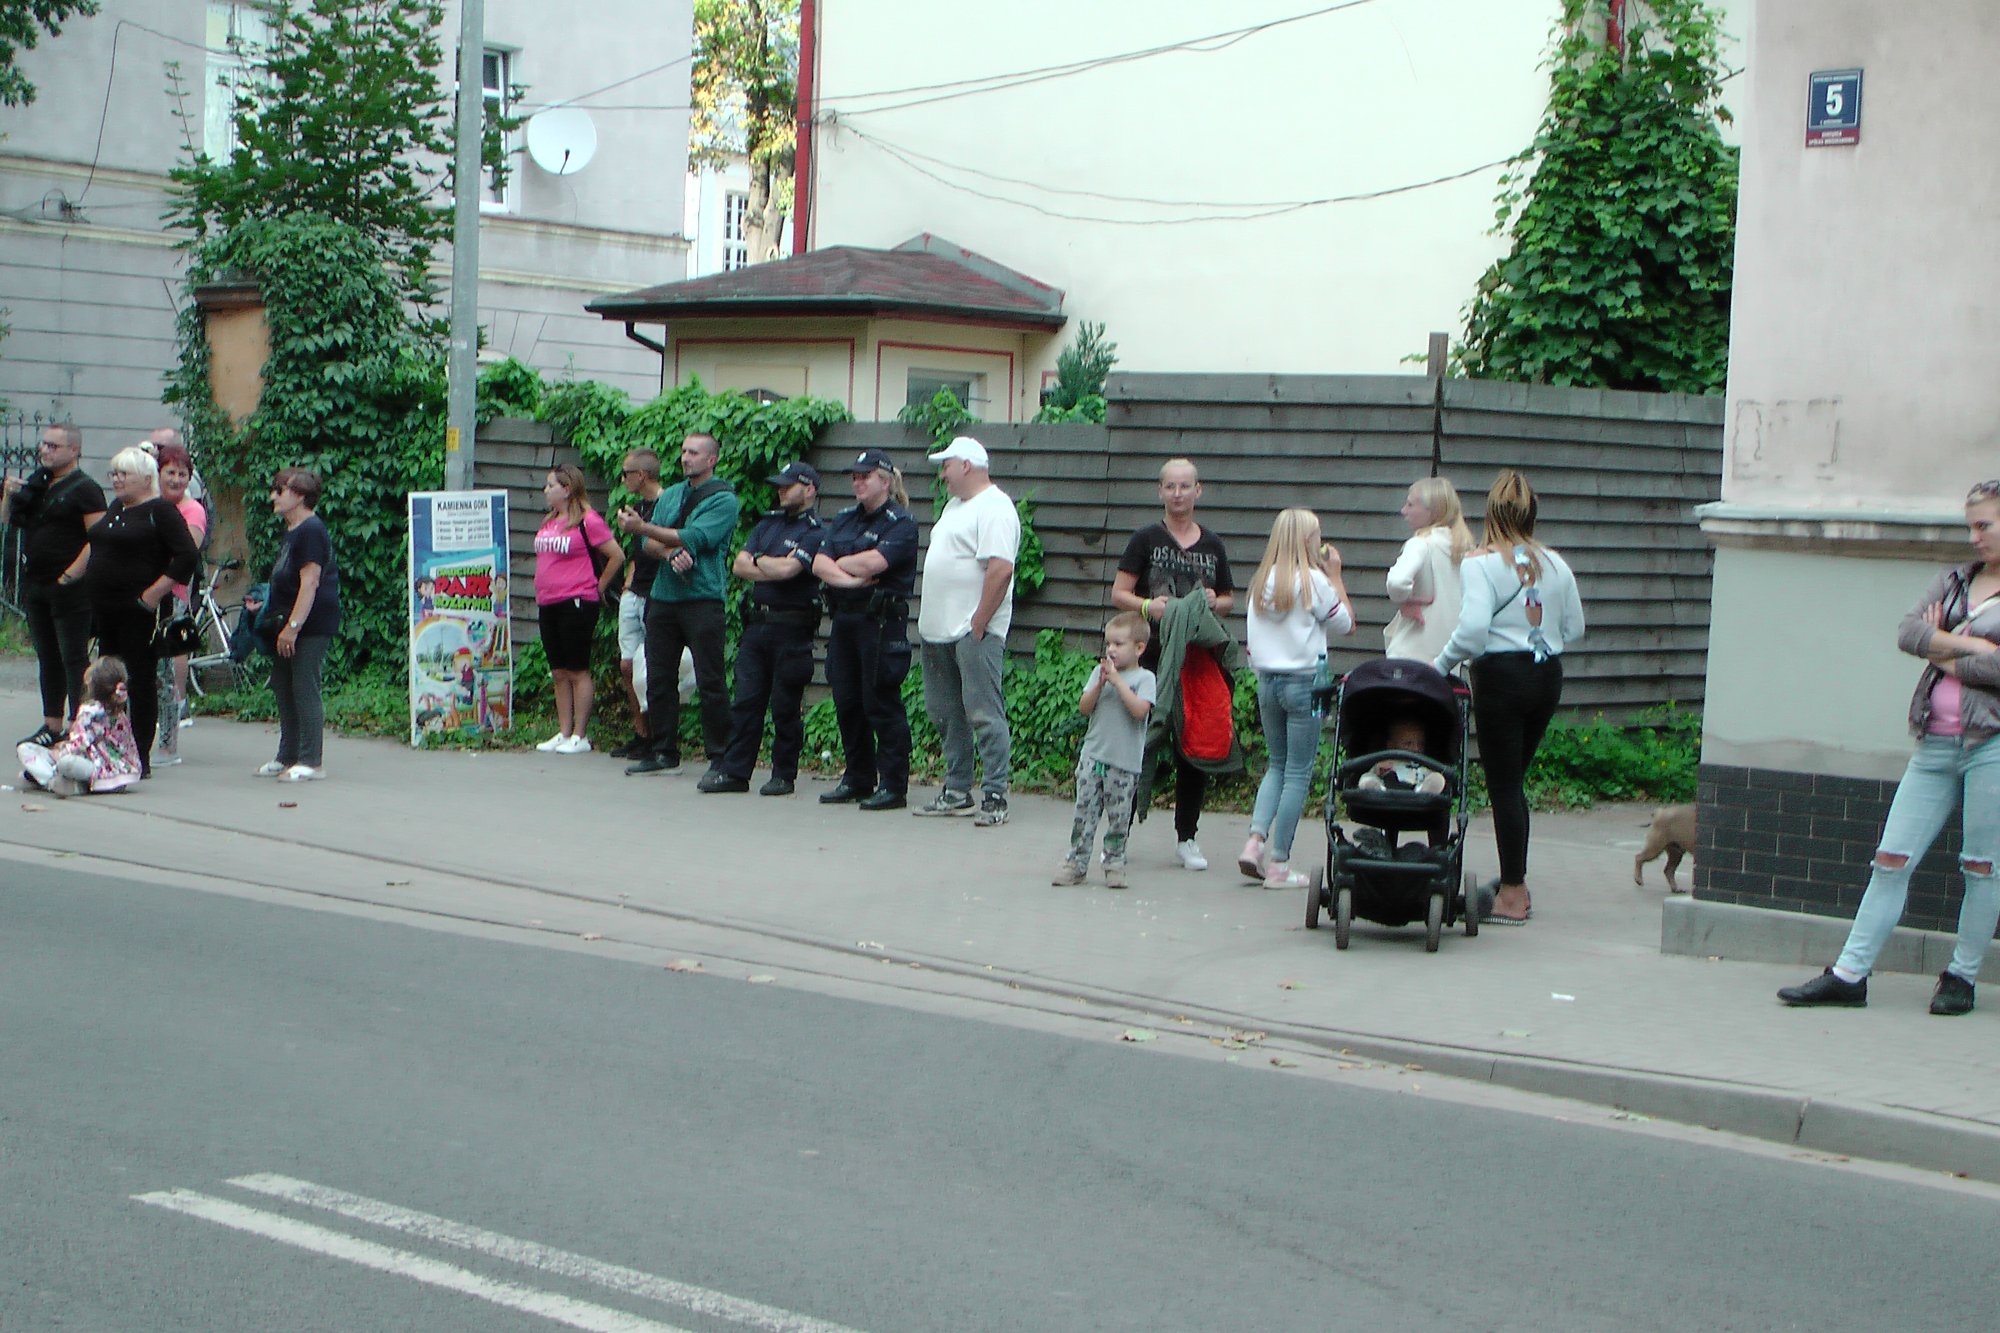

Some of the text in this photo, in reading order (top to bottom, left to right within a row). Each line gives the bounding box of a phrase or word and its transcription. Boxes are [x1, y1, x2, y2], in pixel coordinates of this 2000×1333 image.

[1825, 83, 1843, 116] 5
[437, 501, 472, 511] KAMIENNA
[1149, 545, 1169, 561] OS
[434, 575, 493, 599] PARK
